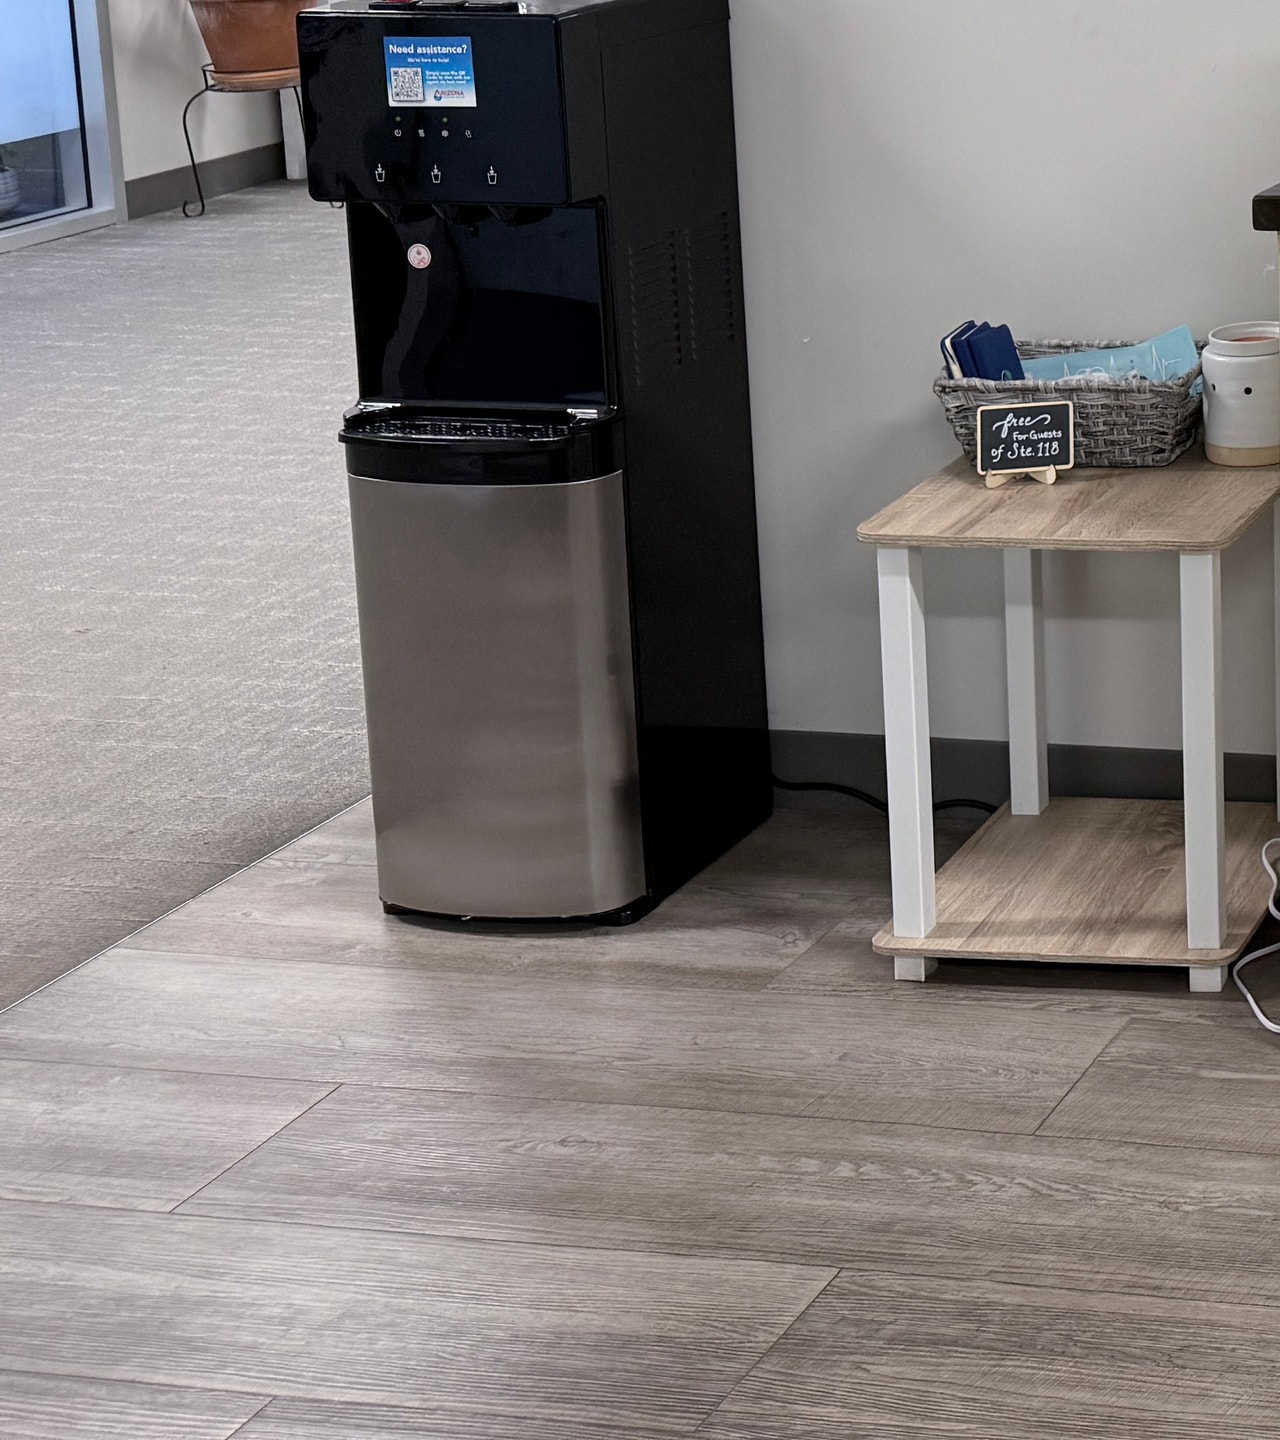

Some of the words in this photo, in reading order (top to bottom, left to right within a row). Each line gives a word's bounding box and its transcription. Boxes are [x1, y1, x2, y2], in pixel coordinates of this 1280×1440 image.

[389, 44, 414, 54] Need
[416, 44, 467, 54] assistance?
[992, 412, 1051, 439] free
[1013, 431, 1029, 441] For
[1029, 430, 1062, 440] Guests
[991, 444, 1005, 463] of
[1007, 442, 1035, 459] Ste.
[1036, 441, 1060, 457] 118
